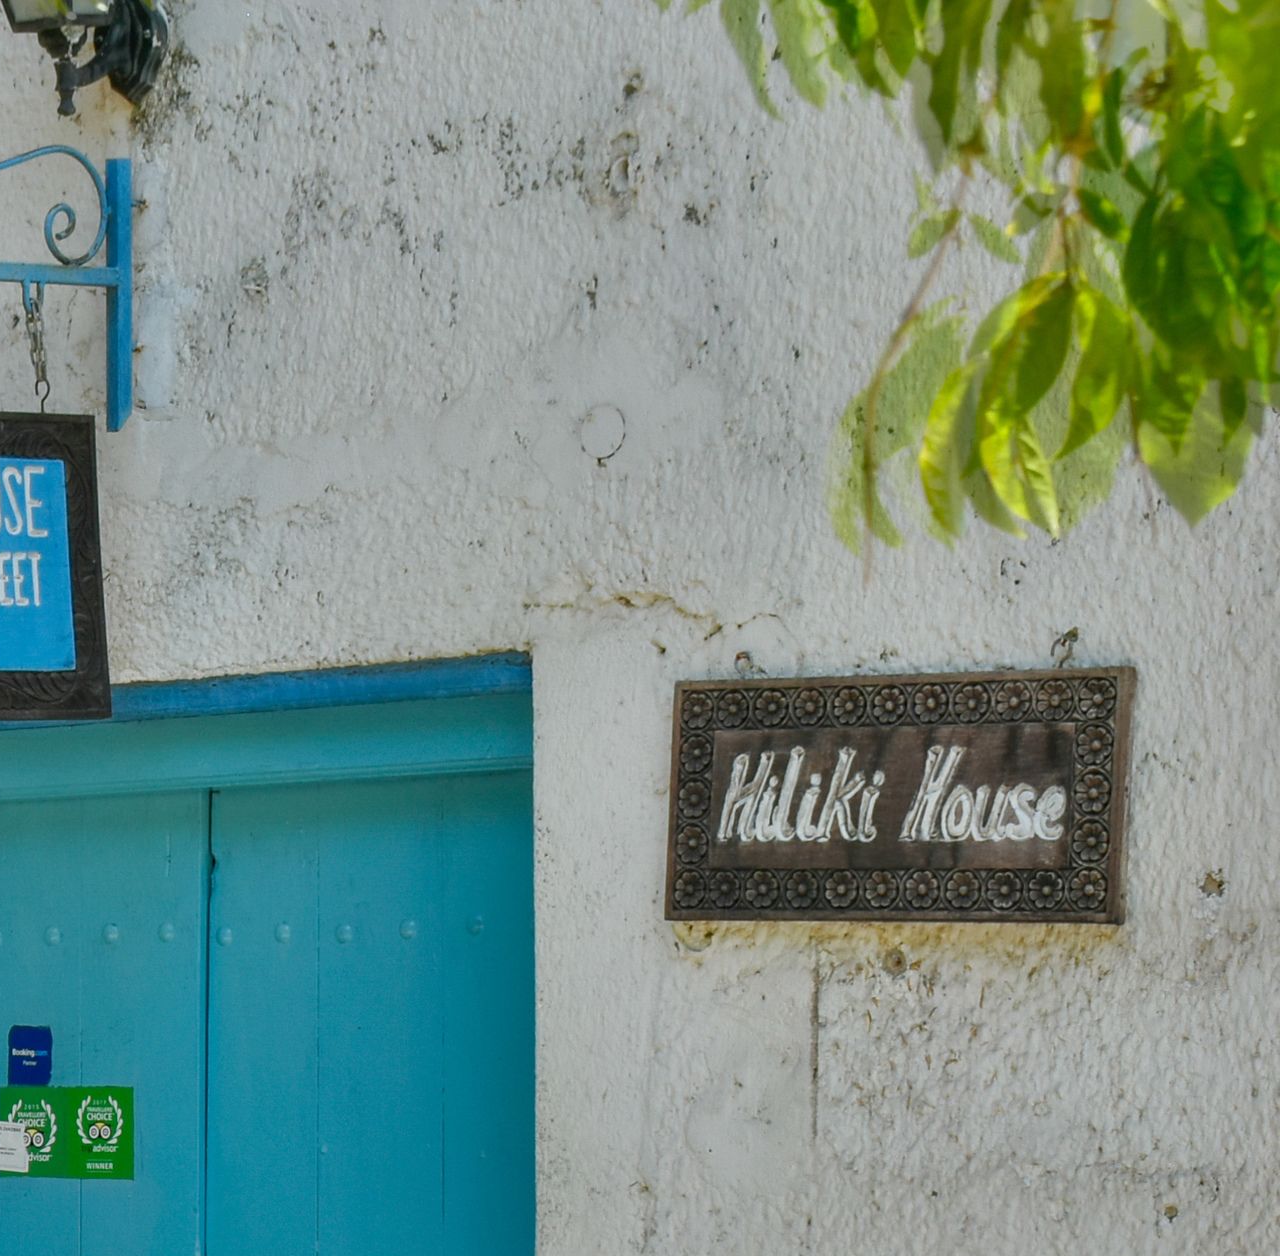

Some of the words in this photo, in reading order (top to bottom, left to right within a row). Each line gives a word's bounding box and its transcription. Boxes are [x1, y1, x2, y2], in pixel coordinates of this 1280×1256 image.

[717, 746, 886, 842] Hiliki
[899, 745, 1068, 842] House
[86, 1113, 113, 1121] CHOICE
[27, 1152, 51, 1162] dvisor
